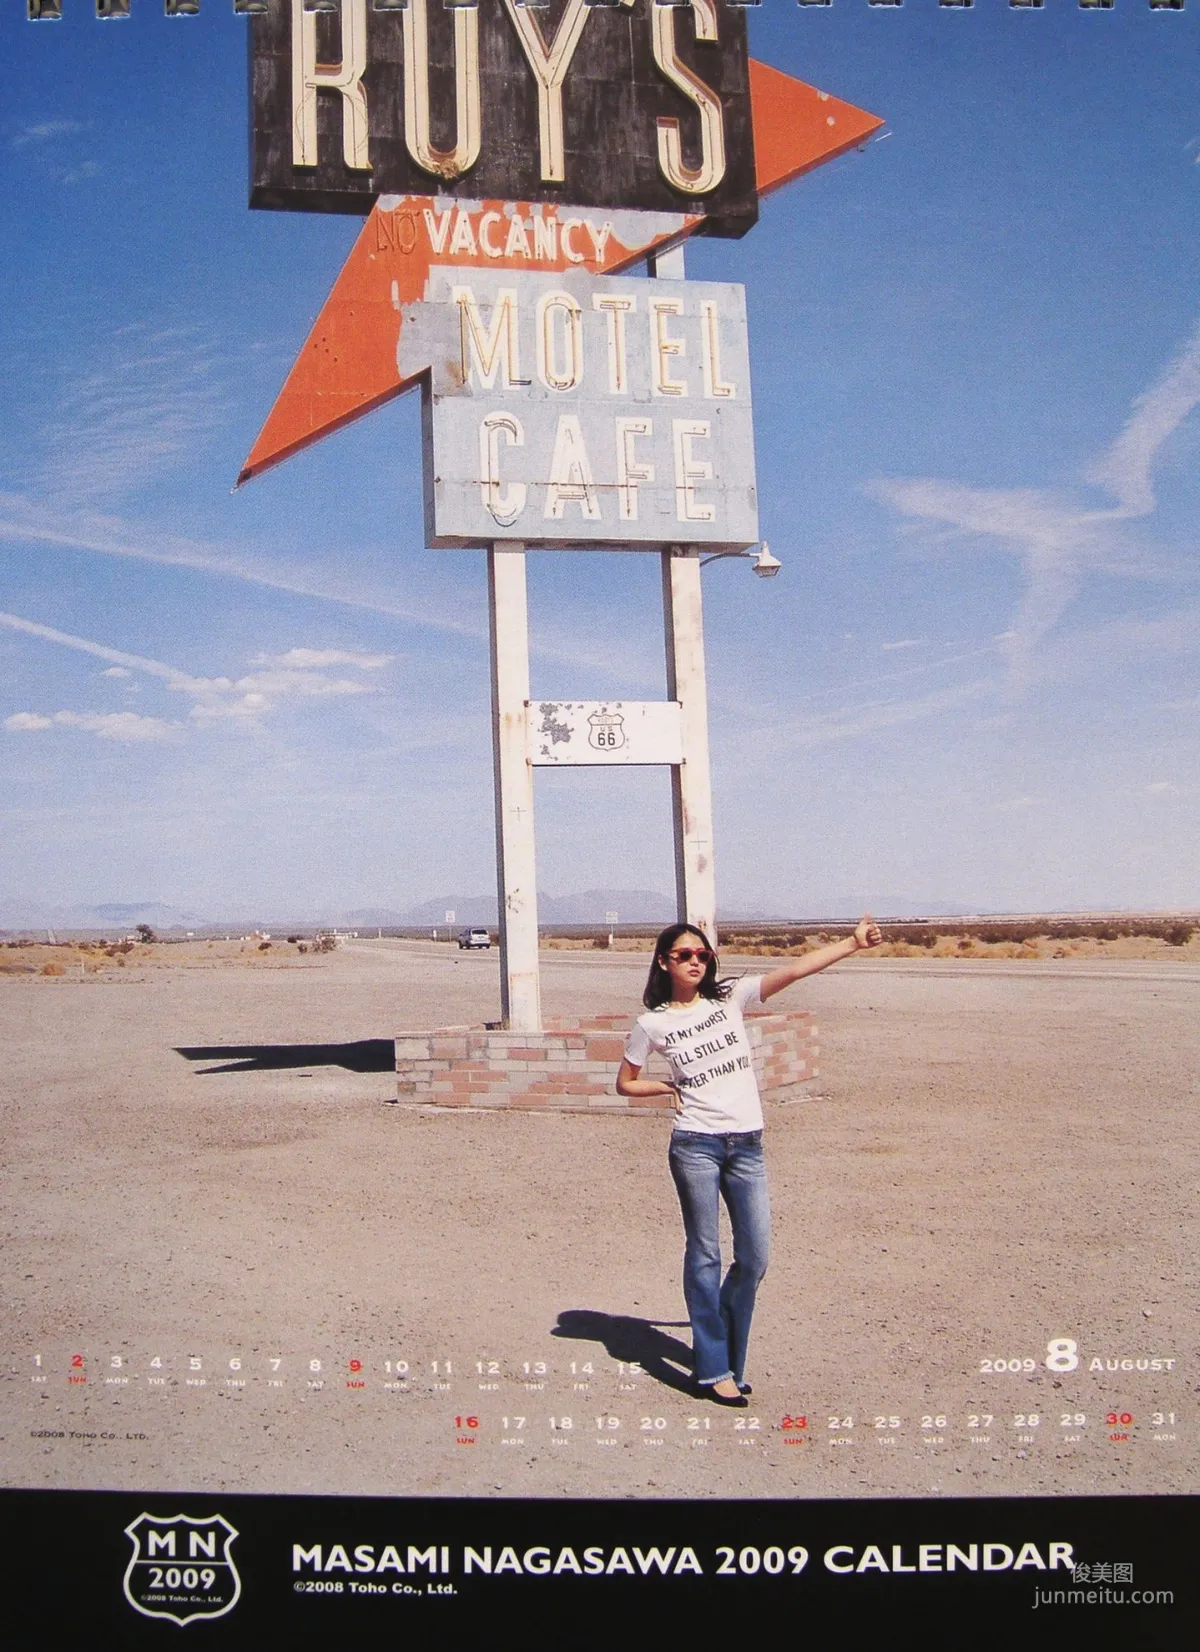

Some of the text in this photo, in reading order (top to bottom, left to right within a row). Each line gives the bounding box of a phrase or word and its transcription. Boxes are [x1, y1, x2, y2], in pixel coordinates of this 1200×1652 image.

[292, 0, 724, 194] ROYS
[376, 209, 612, 263] NO VACANCY
[452, 284, 736, 398] MOTEL
[480, 411, 718, 524] CAFE
[598, 732, 615, 746] 66
[664, 1009, 728, 1047] AT MY WORST
[673, 1031, 739, 1068] I'LL STILL BE
[708, 1060, 735, 1079] THAN
[34, 1354, 642, 1375] 1 2 3 4 5 6 7 8 9 10 11 12 13 14 15
[979, 1358, 1036, 1373] 2009
[1045, 1338, 1079, 1372] 8
[455, 1412, 1176, 1430] 16 17 18 19 20 21 22 23 24 25 26 27 28 29 30 31
[292, 1542, 1076, 1575] MASAMI NAGASAWA 2009 CALENDAR
[149, 1567, 216, 1590] 2009
[349, 1582, 387, 1594] Toho
[391, 1583, 422, 1596] Co.,
[427, 1583, 458, 1595] Ltd.
